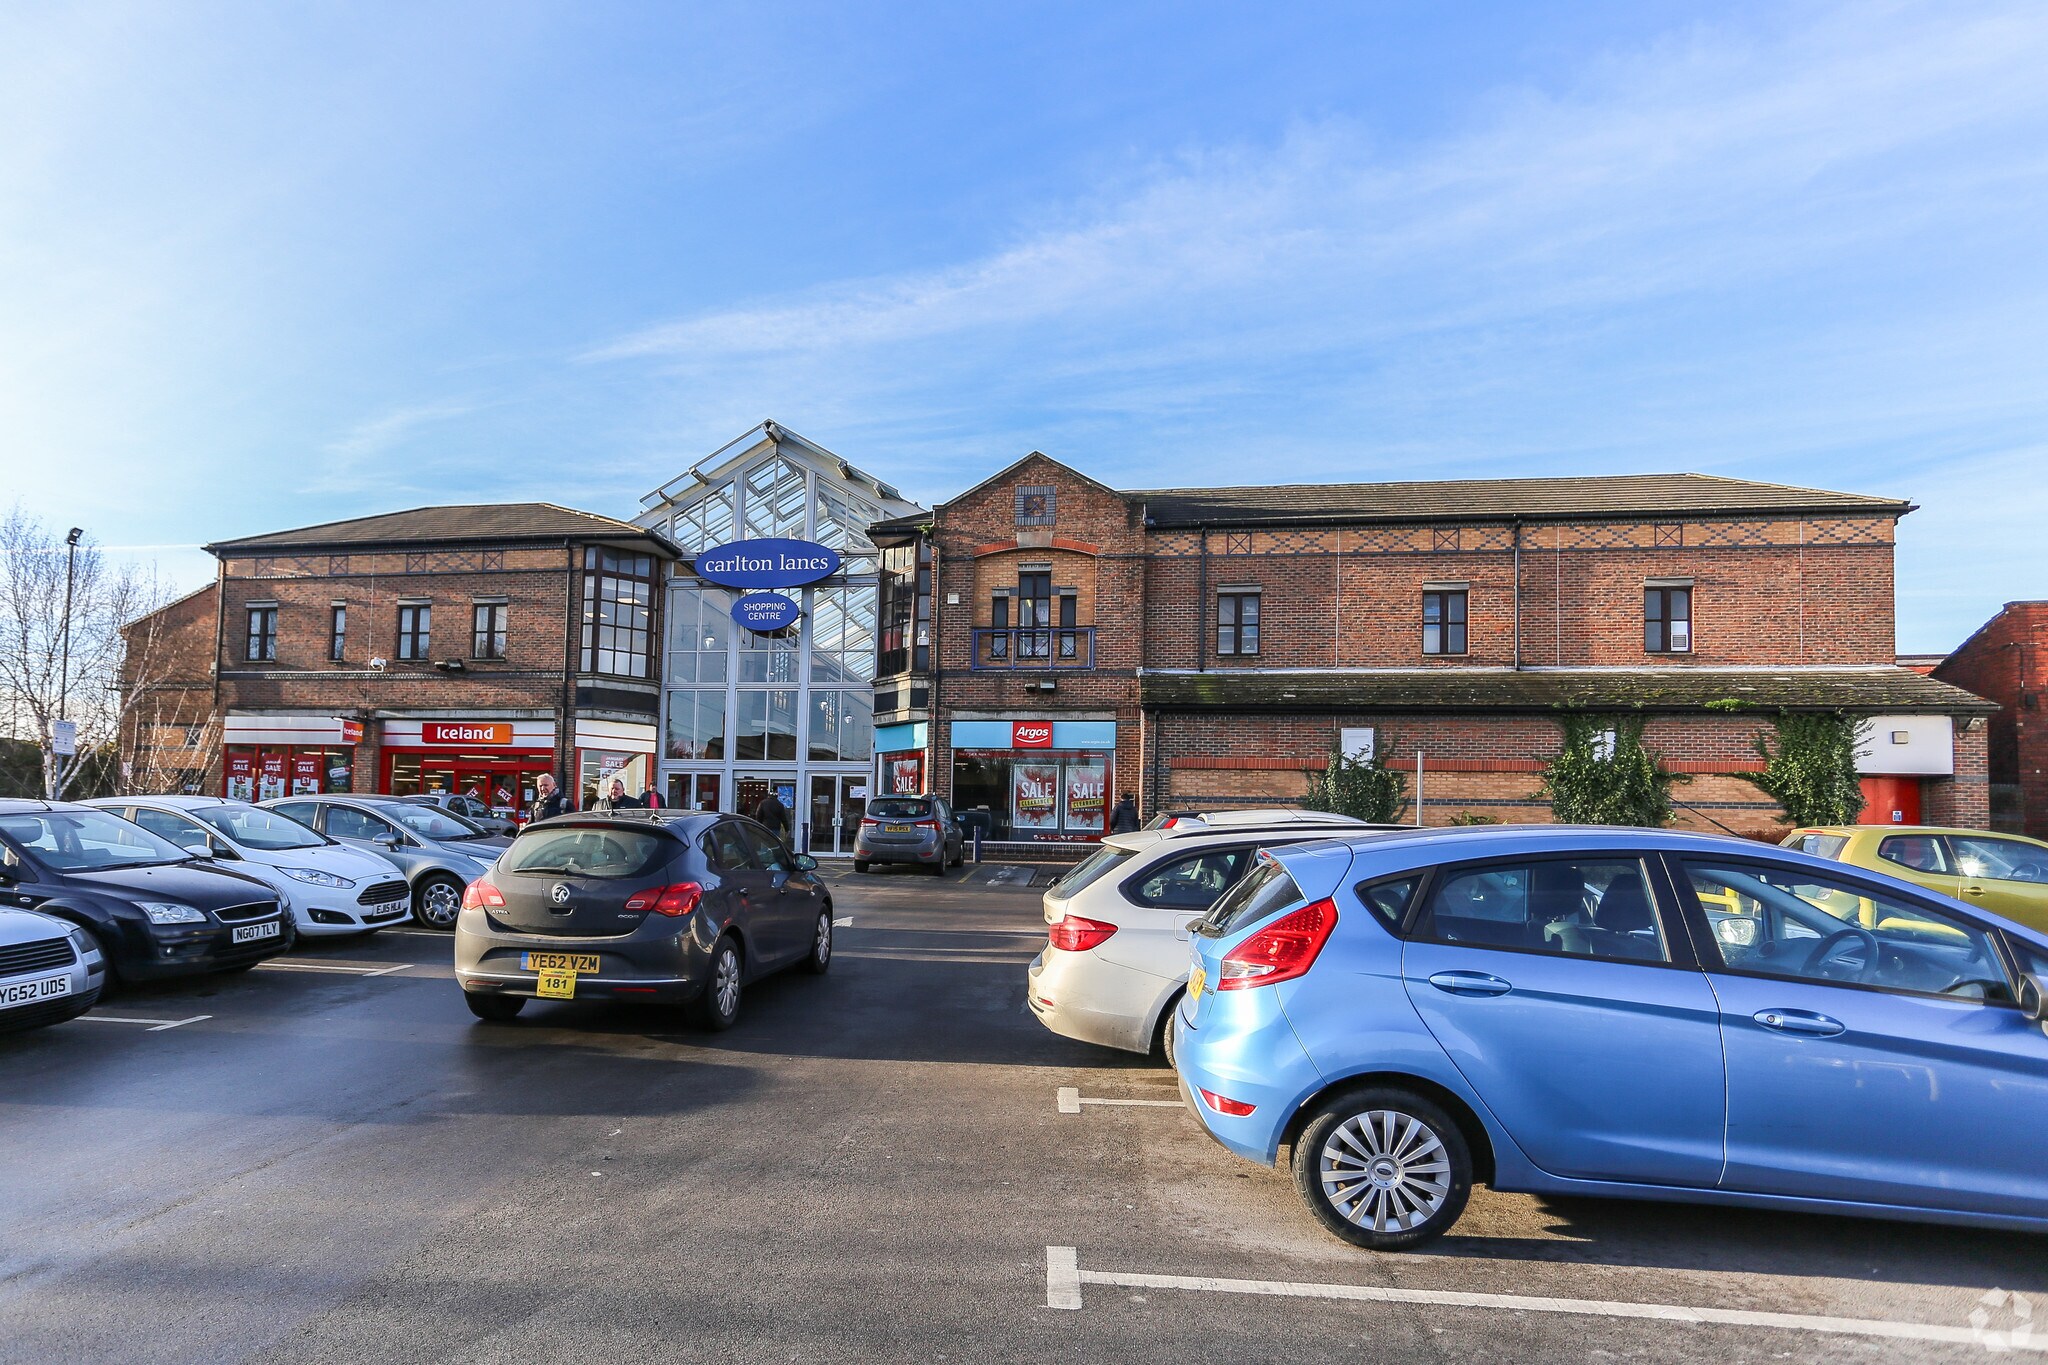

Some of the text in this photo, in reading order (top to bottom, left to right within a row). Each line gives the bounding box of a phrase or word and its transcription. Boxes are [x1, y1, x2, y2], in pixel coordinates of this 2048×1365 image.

[705, 554, 829, 573] carlton lanes
[743, 602, 786, 612] SHOPPING
[748, 612, 781, 620] CENTRE
[343, 727, 363, 737] Iceland
[436, 726, 494, 740] Iceland
[1015, 726, 1049, 739] Argos
[264, 764, 281, 772] SALE
[236, 774, 245, 783] £1
[301, 776, 310, 784] £1
[497, 790, 511, 802] SALE
[1021, 798, 1051, 806] CLEARANCE
[1073, 799, 1102, 808] CLEARANCE
[376, 903, 390, 914] EJ15
[236, 923, 277, 941] NG07 TLY
[530, 953, 598, 971] YE62 VZM
[545, 977, 568, 989] 181
[0, 977, 66, 1004] YG52 UDS
